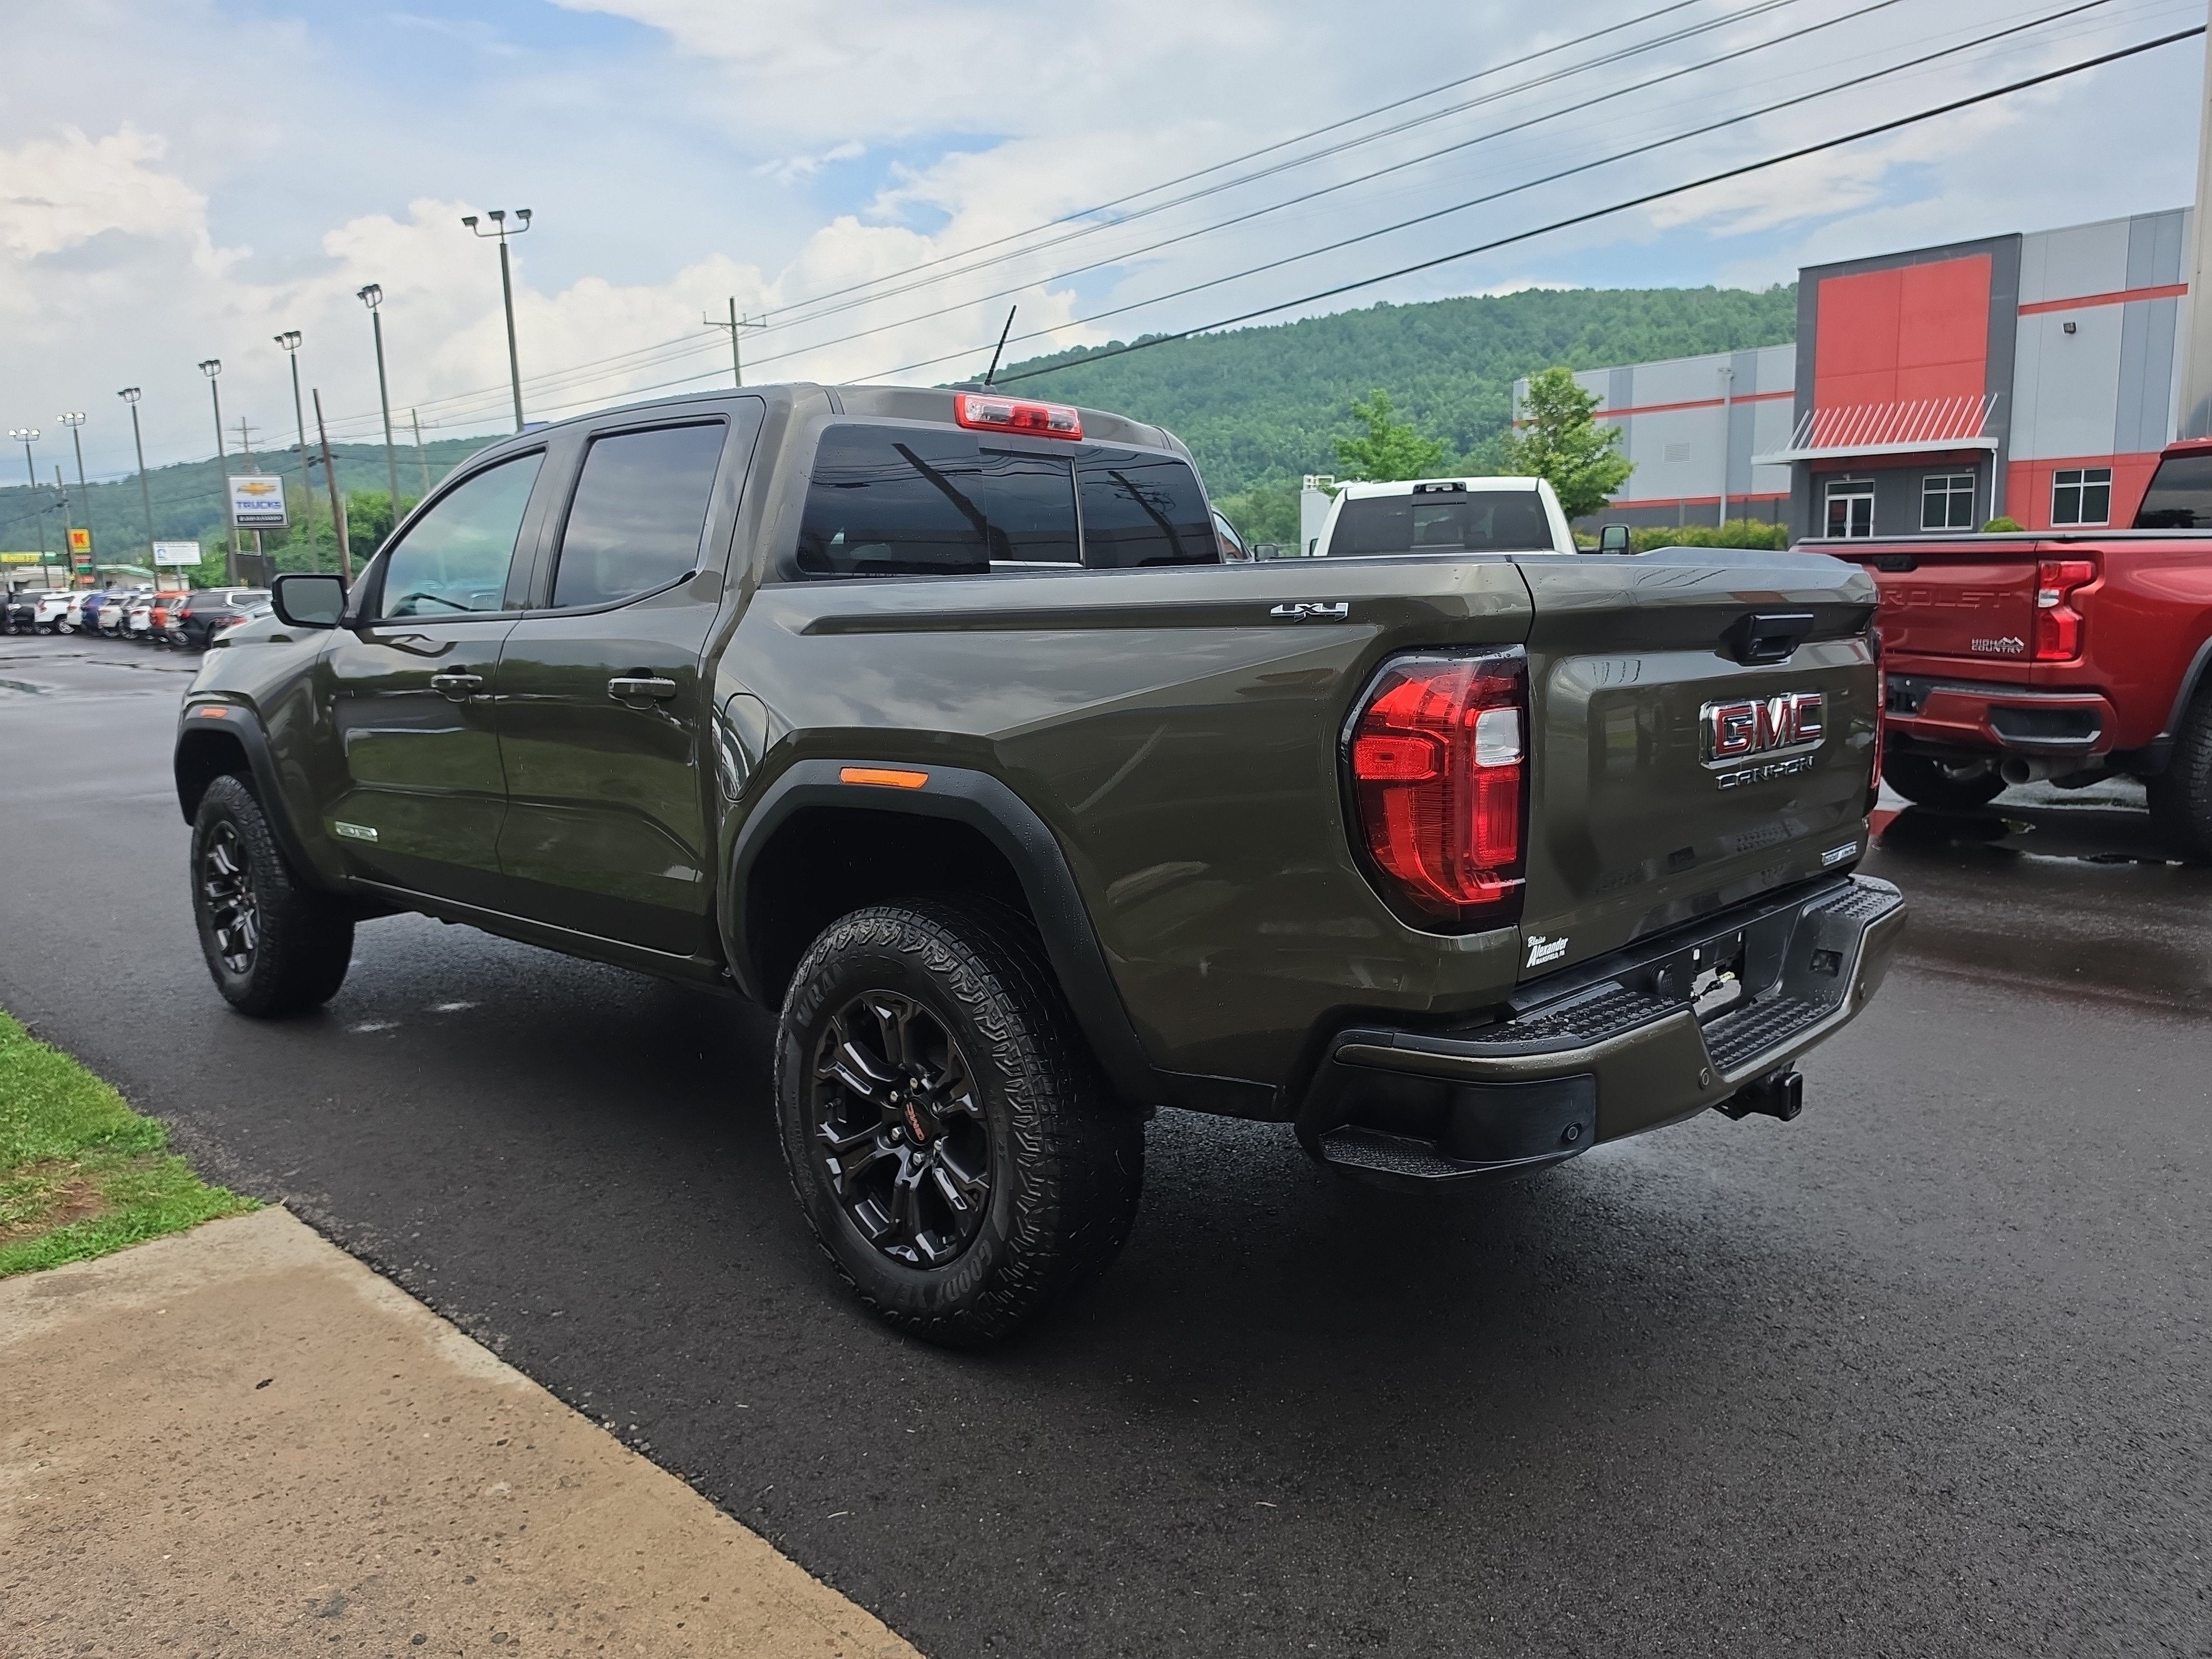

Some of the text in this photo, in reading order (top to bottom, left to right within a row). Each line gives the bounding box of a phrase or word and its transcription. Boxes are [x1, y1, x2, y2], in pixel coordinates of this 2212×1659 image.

[236, 501, 281, 509] TRUCKS
[1882, 590, 2011, 608] ROLET
[1971, 638, 1998, 647] HIGH
[1971, 645, 2024, 654] COUNTRY
[1711, 693, 1823, 759] GMC
[1715, 755, 1814, 790] CANYON
[1526, 937, 1568, 968] Alexander
